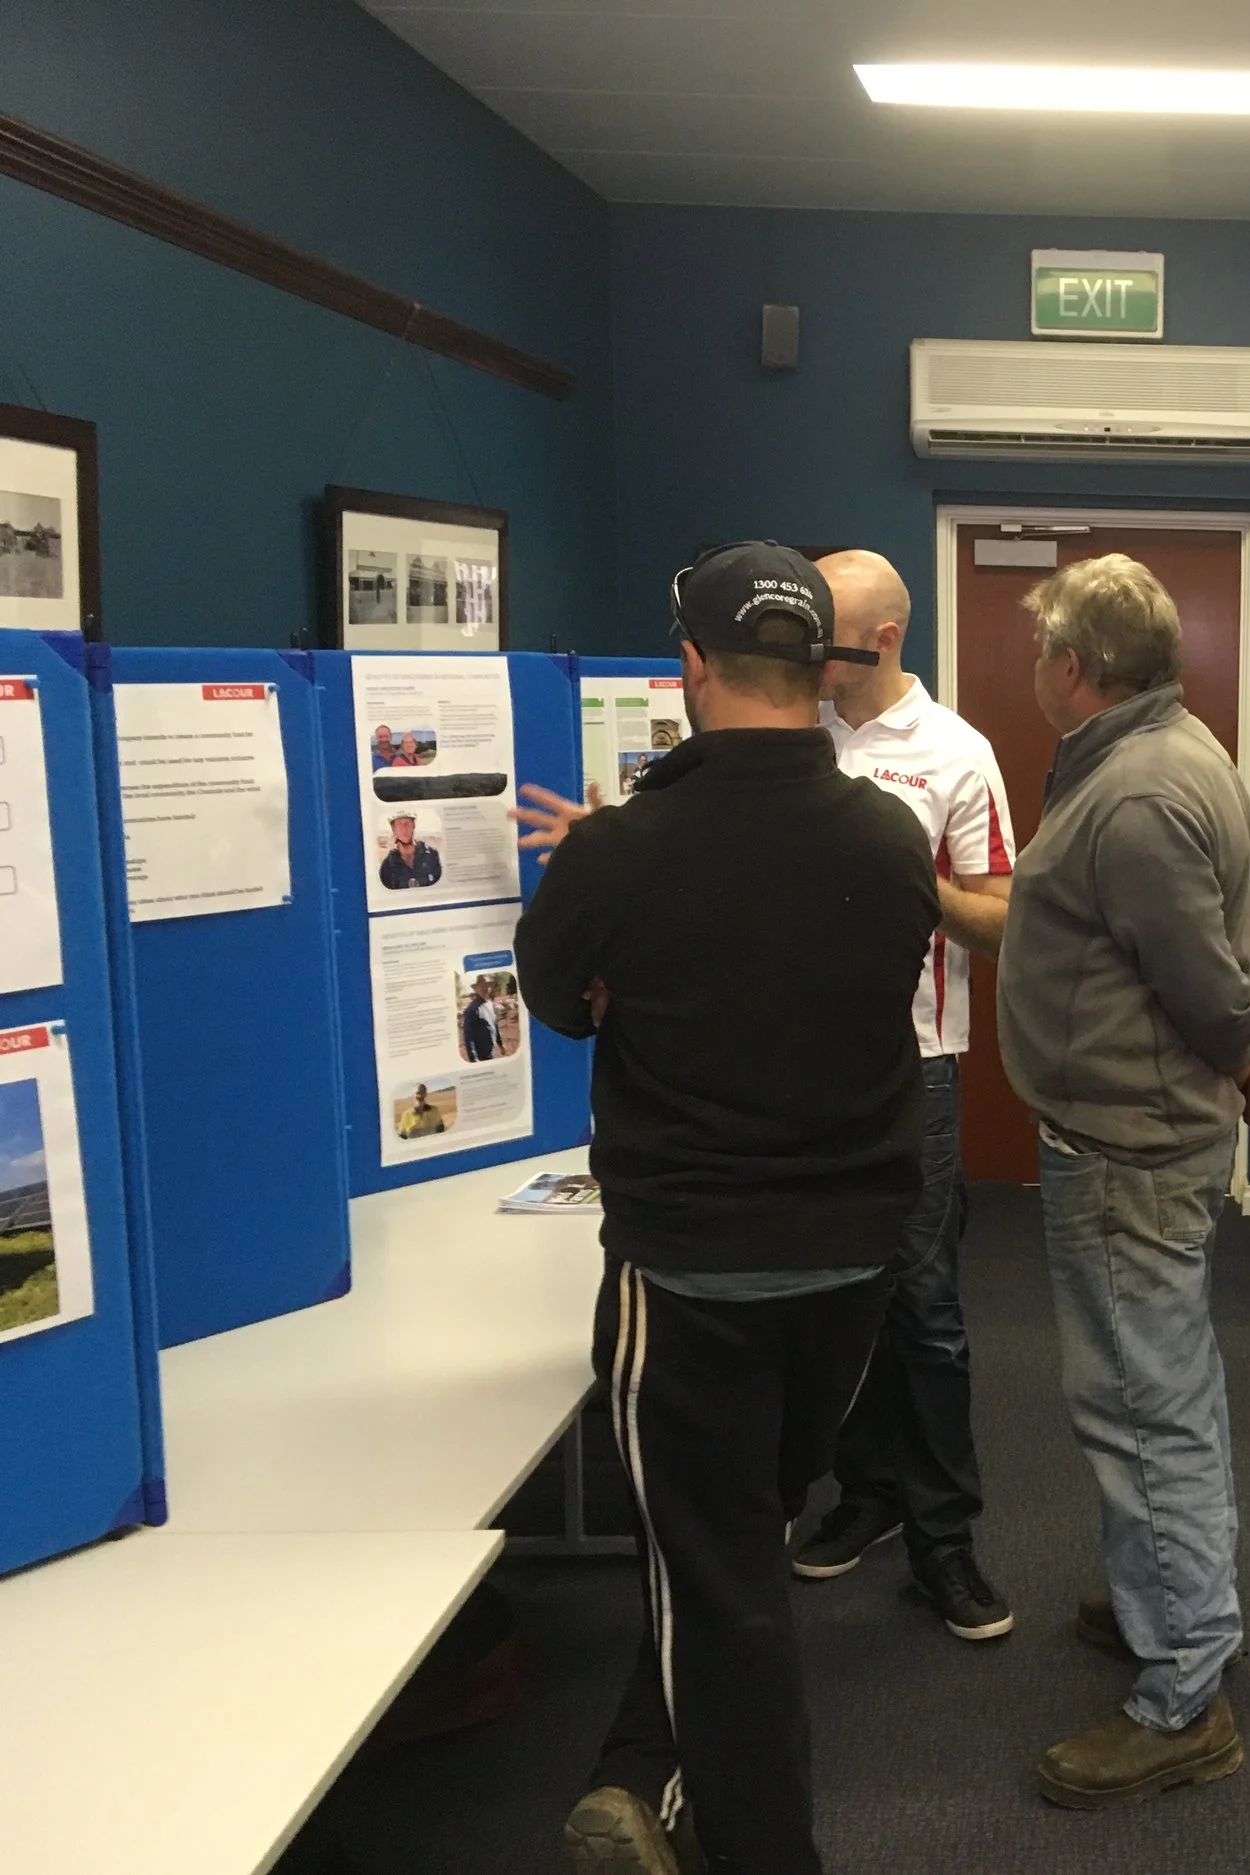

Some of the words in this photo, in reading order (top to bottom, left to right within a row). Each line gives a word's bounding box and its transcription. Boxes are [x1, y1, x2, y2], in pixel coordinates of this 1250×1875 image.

[1059, 277, 1133, 319] EXIT
[753, 580, 778, 589] 1300
[780, 581, 798, 592] 453
[212, 687, 254, 698] LACOUR
[873, 767, 928, 790] LACOUR
